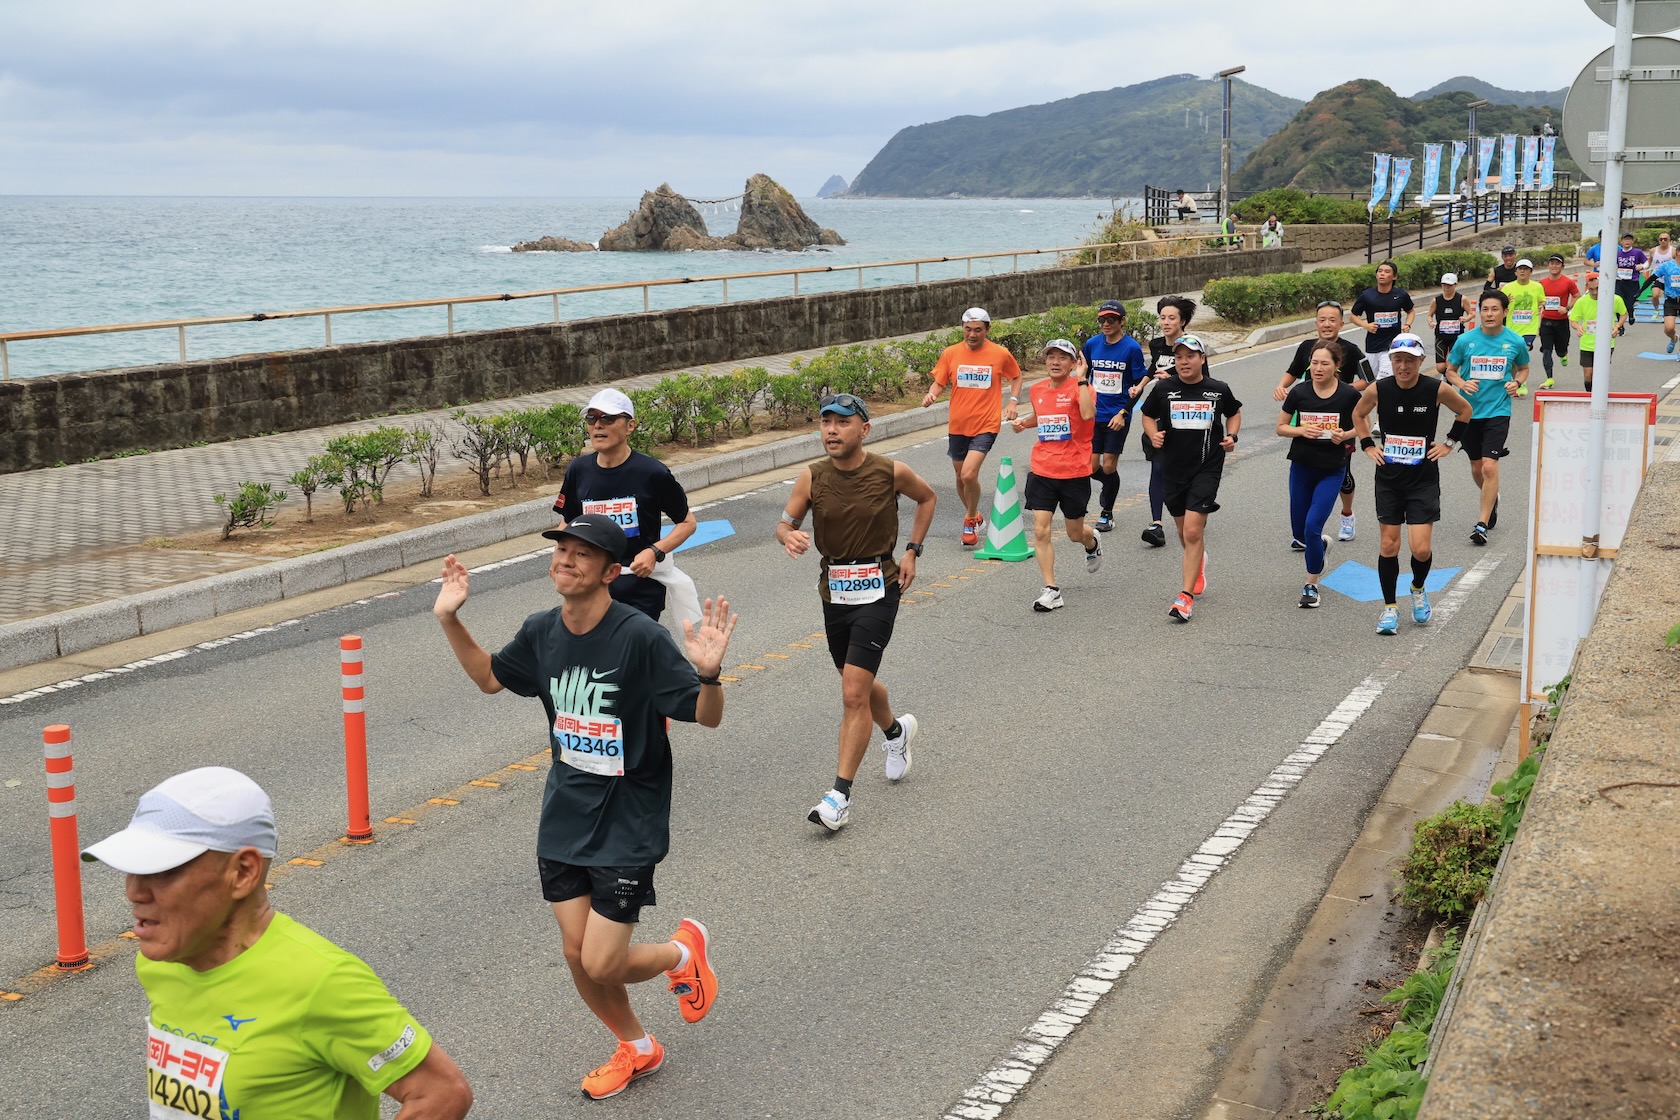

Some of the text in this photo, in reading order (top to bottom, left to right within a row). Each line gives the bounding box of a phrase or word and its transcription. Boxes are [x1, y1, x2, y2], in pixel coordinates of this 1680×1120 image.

[1181, 412, 1206, 420] 11741
[1042, 424, 1069, 433] 12296
[1385, 437, 1424, 446] 福岡トヨタ
[1392, 446, 1422, 456] 11044
[584, 502, 633, 514] 福岡トヨタ
[609, 513, 633, 525] 213
[830, 567, 879, 578] 福岡トヨタ
[839, 577, 881, 592] 12890
[549, 665, 621, 718] NIKE
[555, 716, 618, 738] 福岡トヨタ
[564, 733, 619, 757] 12346
[148, 1036, 221, 1088] 岡トヨタ
[148, 1068, 215, 1120] 14202
